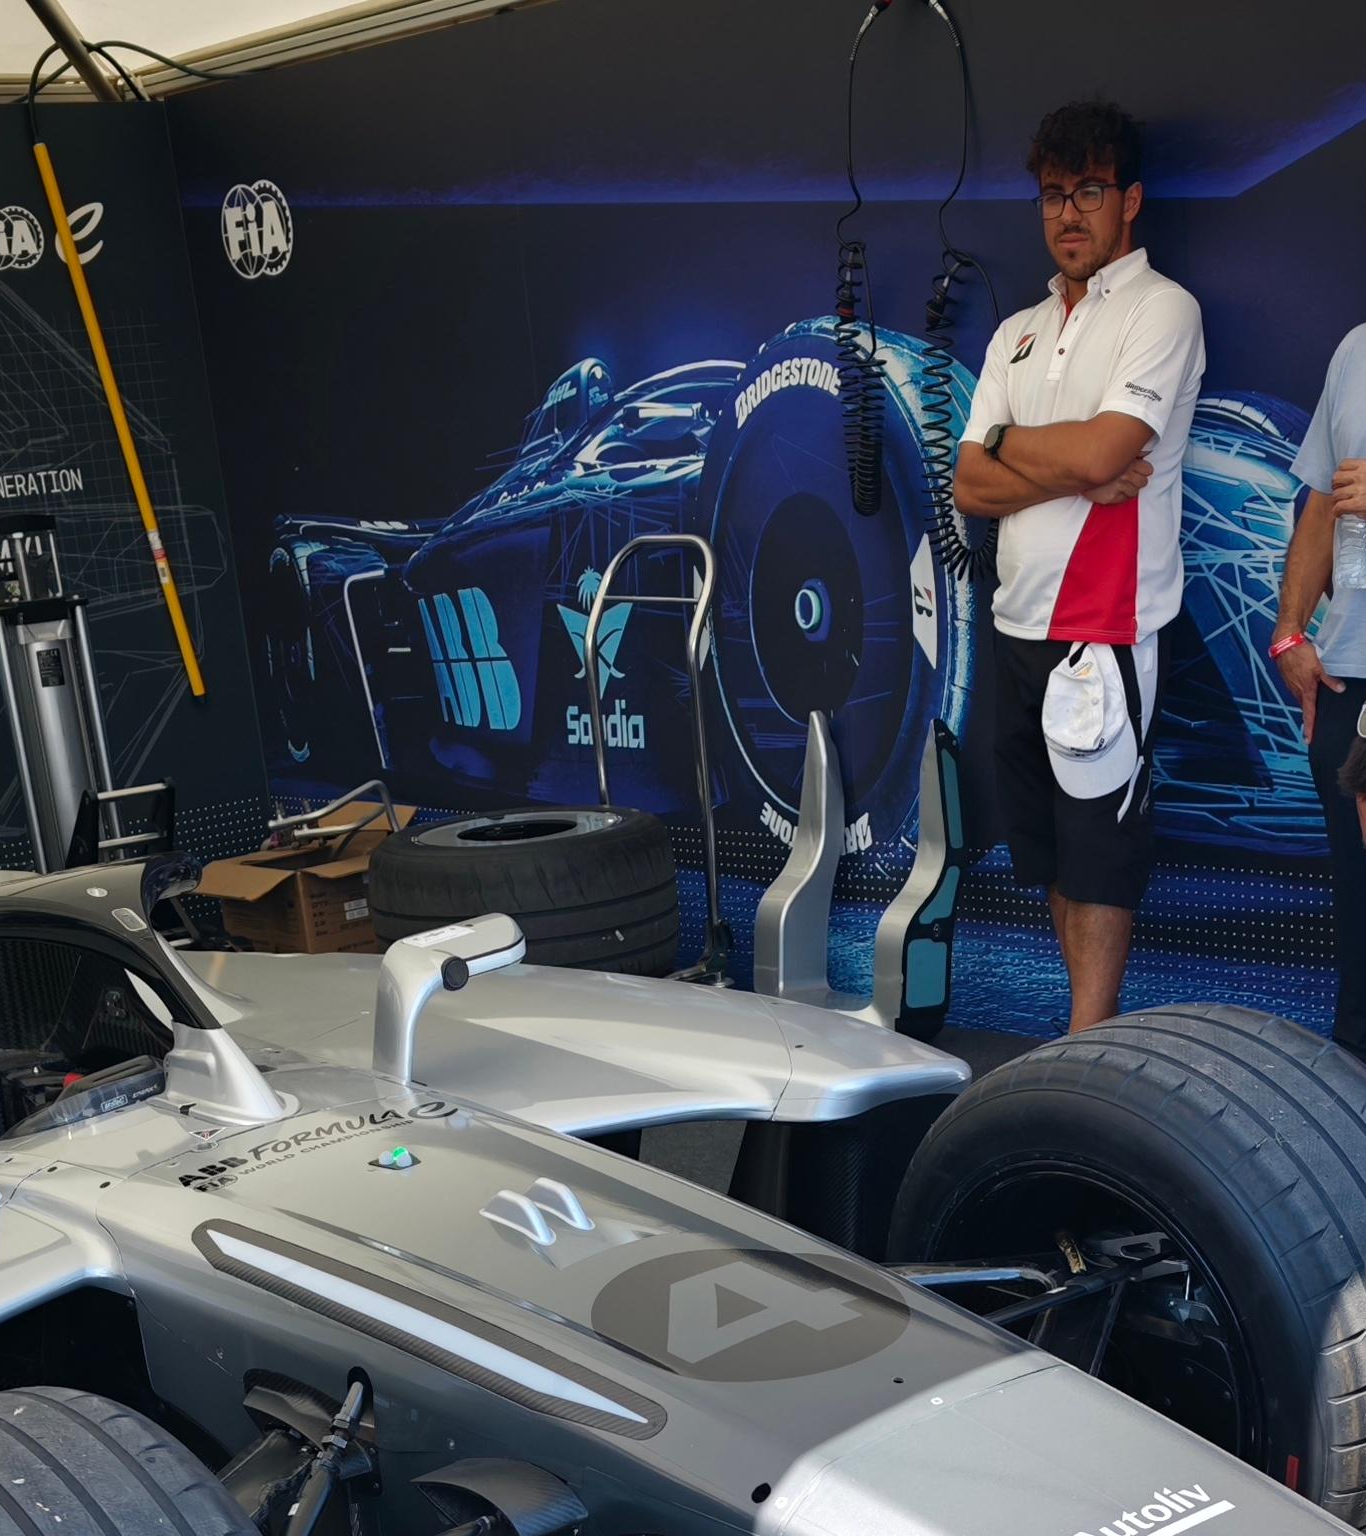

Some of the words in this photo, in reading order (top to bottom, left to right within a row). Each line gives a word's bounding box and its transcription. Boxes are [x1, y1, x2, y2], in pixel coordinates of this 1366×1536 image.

[735, 358, 842, 430] BRIDGESTONE
[418, 587, 522, 731] ABB
[566, 699, 646, 749] Sadia
[178, 1156, 248, 1187] ABB
[248, 1109, 405, 1161] FORMULA
[239, 1153, 295, 1175] WORLD
[301, 1119, 414, 1153] CHAMPIONSHIP
